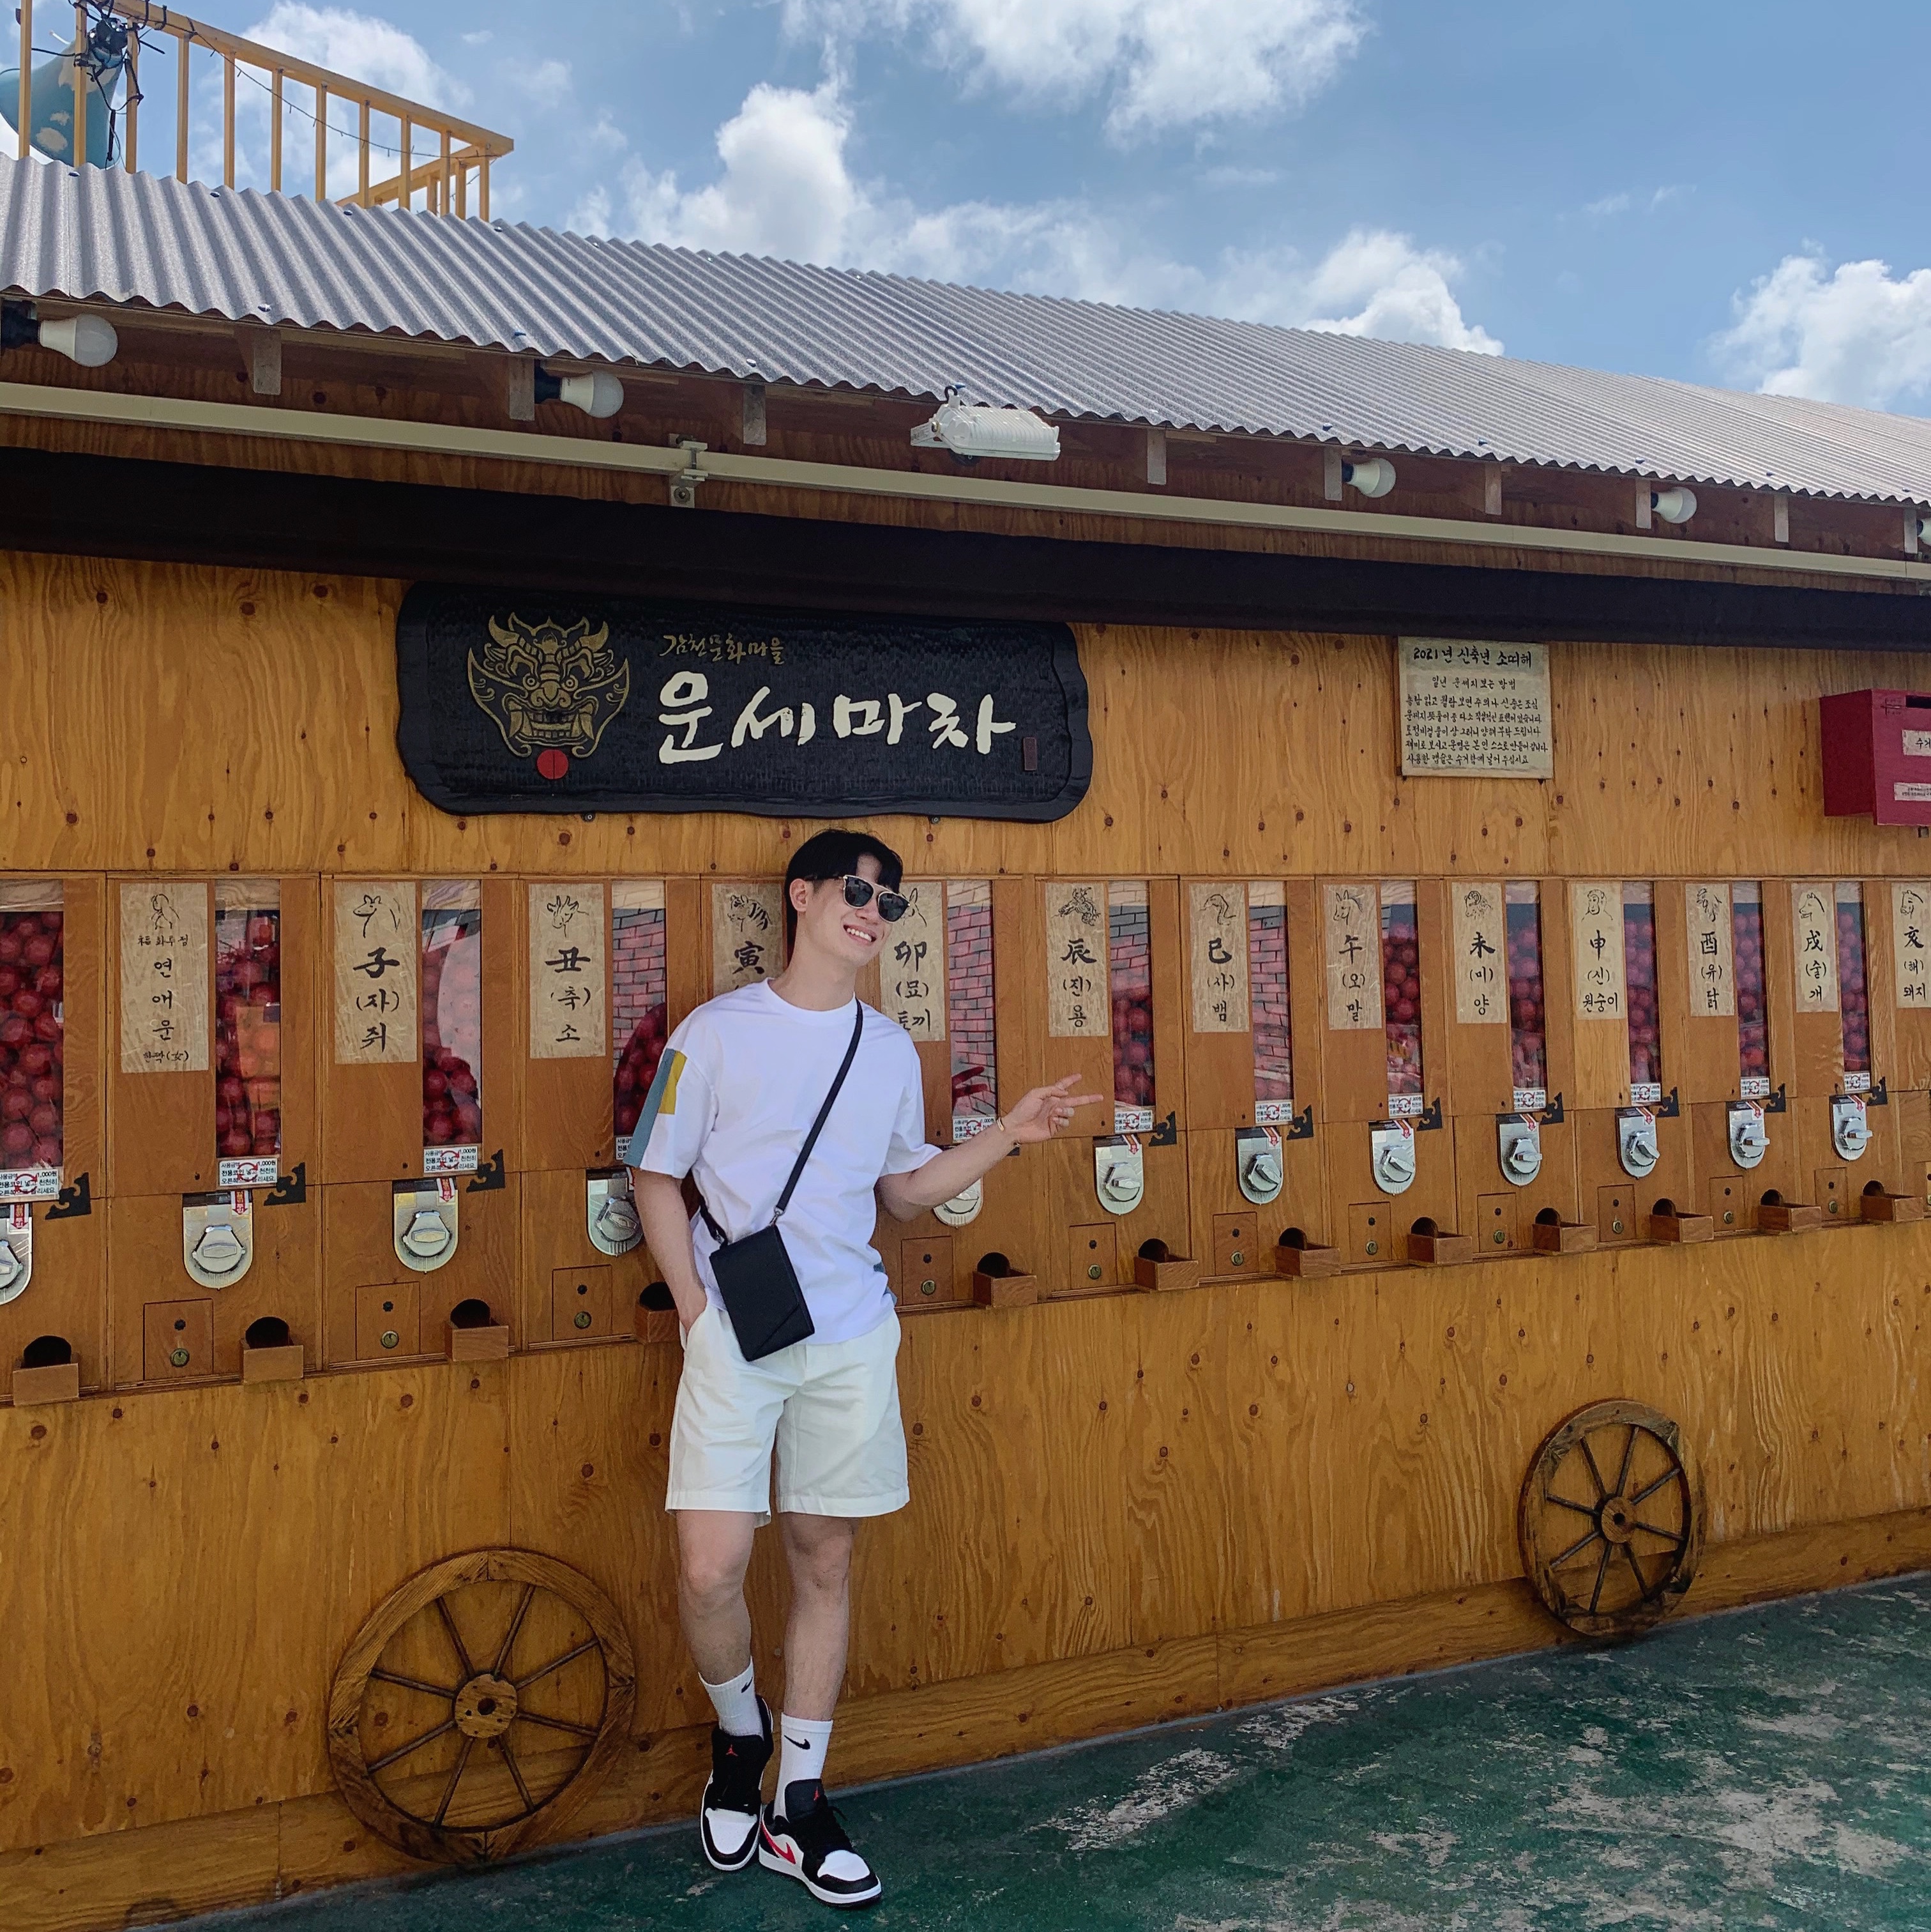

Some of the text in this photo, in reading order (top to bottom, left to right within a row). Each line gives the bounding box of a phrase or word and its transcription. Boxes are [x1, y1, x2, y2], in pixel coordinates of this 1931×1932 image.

[659, 632, 785, 665] 감천문화마을
[1457, 646, 1490, 666] 신축년
[1496, 651, 1532, 669] 소띠해
[1432, 675, 1447, 688] 일년
[1480, 678, 1495, 689] 보는
[1499, 678, 1516, 690] 방법
[658, 671, 1017, 764] 운세마차
[1469, 931, 1496, 959] 未
[1589, 929, 1606, 961] 申
[1700, 931, 1718, 956] 酉
[1803, 929, 1824, 952] 戌
[1903, 925, 1925, 948] 亥
[544, 947, 591, 973] 丑
[732, 940, 765, 975] 寅
[894, 940, 928, 973] 卯
[1060, 938, 1098, 966] 辰
[1338, 934, 1363, 965] 午
[352, 947, 401, 979] 子
[1469, 965, 1494, 984] (미)
[1700, 963, 1723, 983] (유)
[1805, 959, 1827, 979] (술)
[1904, 959, 1924, 976] (해)
[1063, 975, 1091, 997] (진)
[1207, 972, 1235, 992] (사)
[1342, 973, 1366, 989] (오)
[1587, 966, 1610, 985] (신)
[356, 988, 400, 1012] (자)
[550, 987, 591, 1012] (축)
[895, 979, 929, 998] (묘)
[1706, 987, 1720, 1010] 닭
[1808, 985, 1823, 1003] 개
[1903, 983, 1927, 1002] 돼지
[1212, 1000, 1227, 1023] 뱀
[1345, 998, 1363, 1023] 말
[1474, 993, 1490, 1015] 양
[1582, 991, 1619, 1013] 원숭이
[897, 1008, 930, 1033] 토끼
[1068, 1003, 1087, 1028] 용
[360, 1022, 387, 1053] 쥐
[555, 1024, 581, 1043] 소
